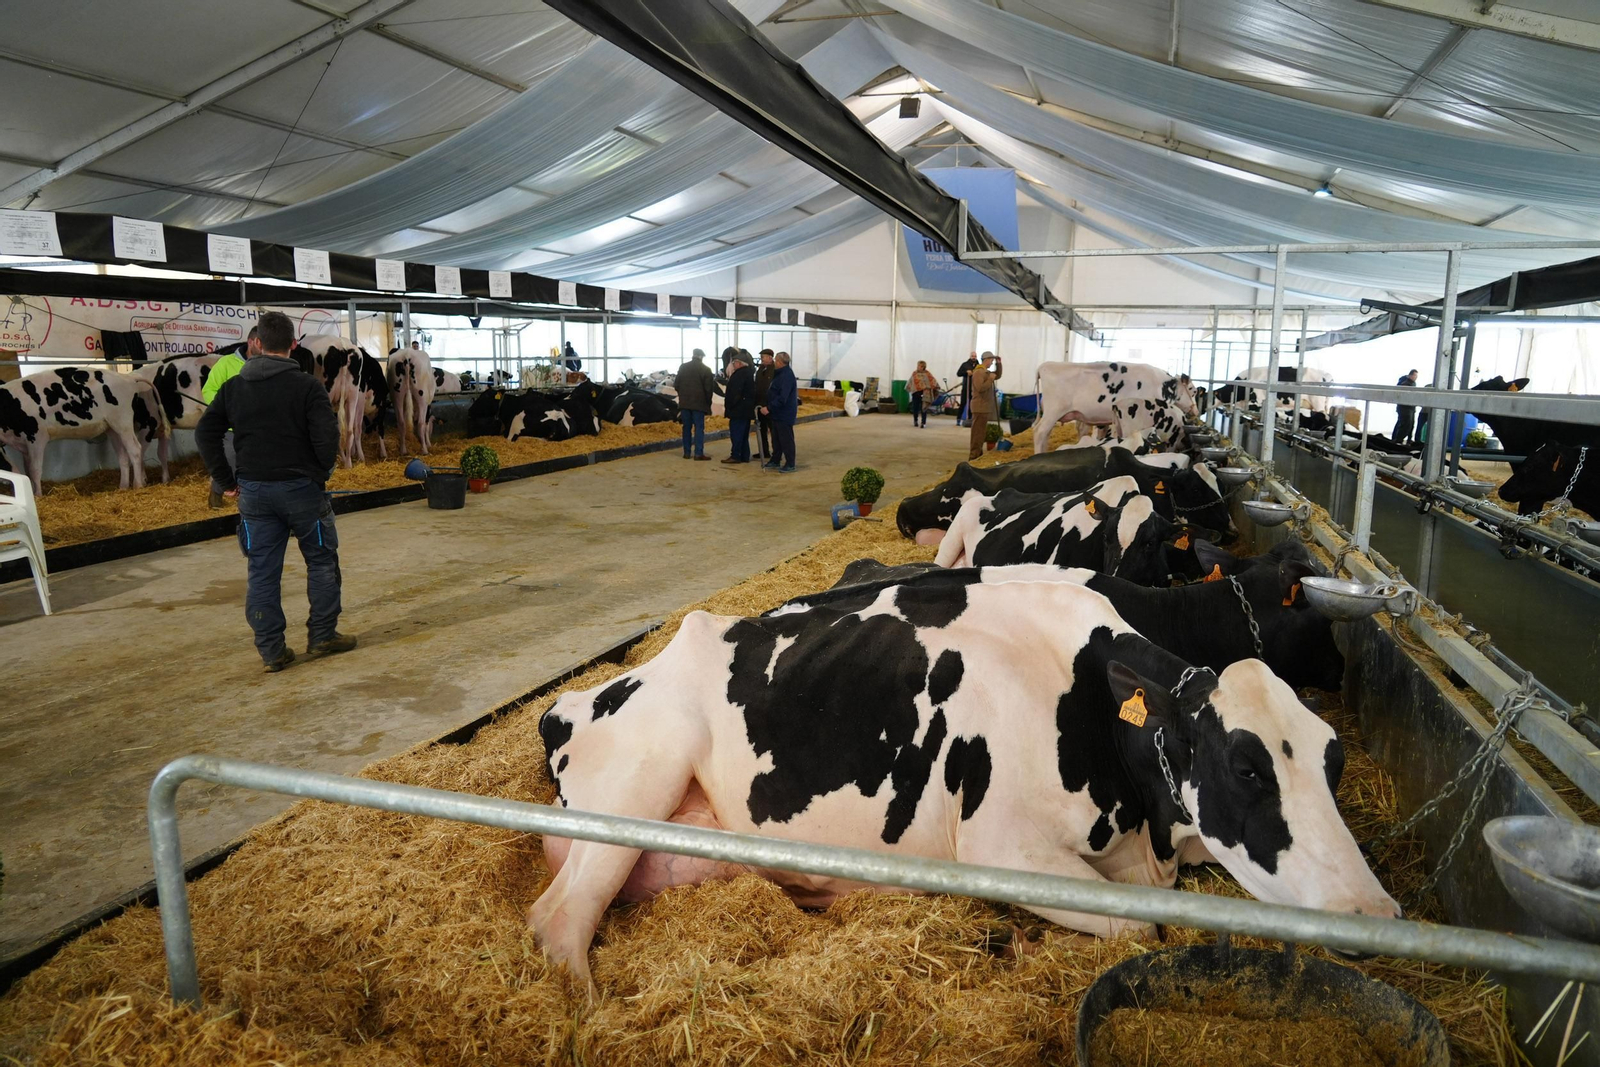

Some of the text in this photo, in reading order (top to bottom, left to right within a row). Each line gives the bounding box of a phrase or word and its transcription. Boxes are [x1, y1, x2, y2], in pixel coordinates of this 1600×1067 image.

[41, 241, 50, 249] 37
[70, 296, 169, 312] A.D.S.G.
[1121, 709, 1144, 726] 0245
